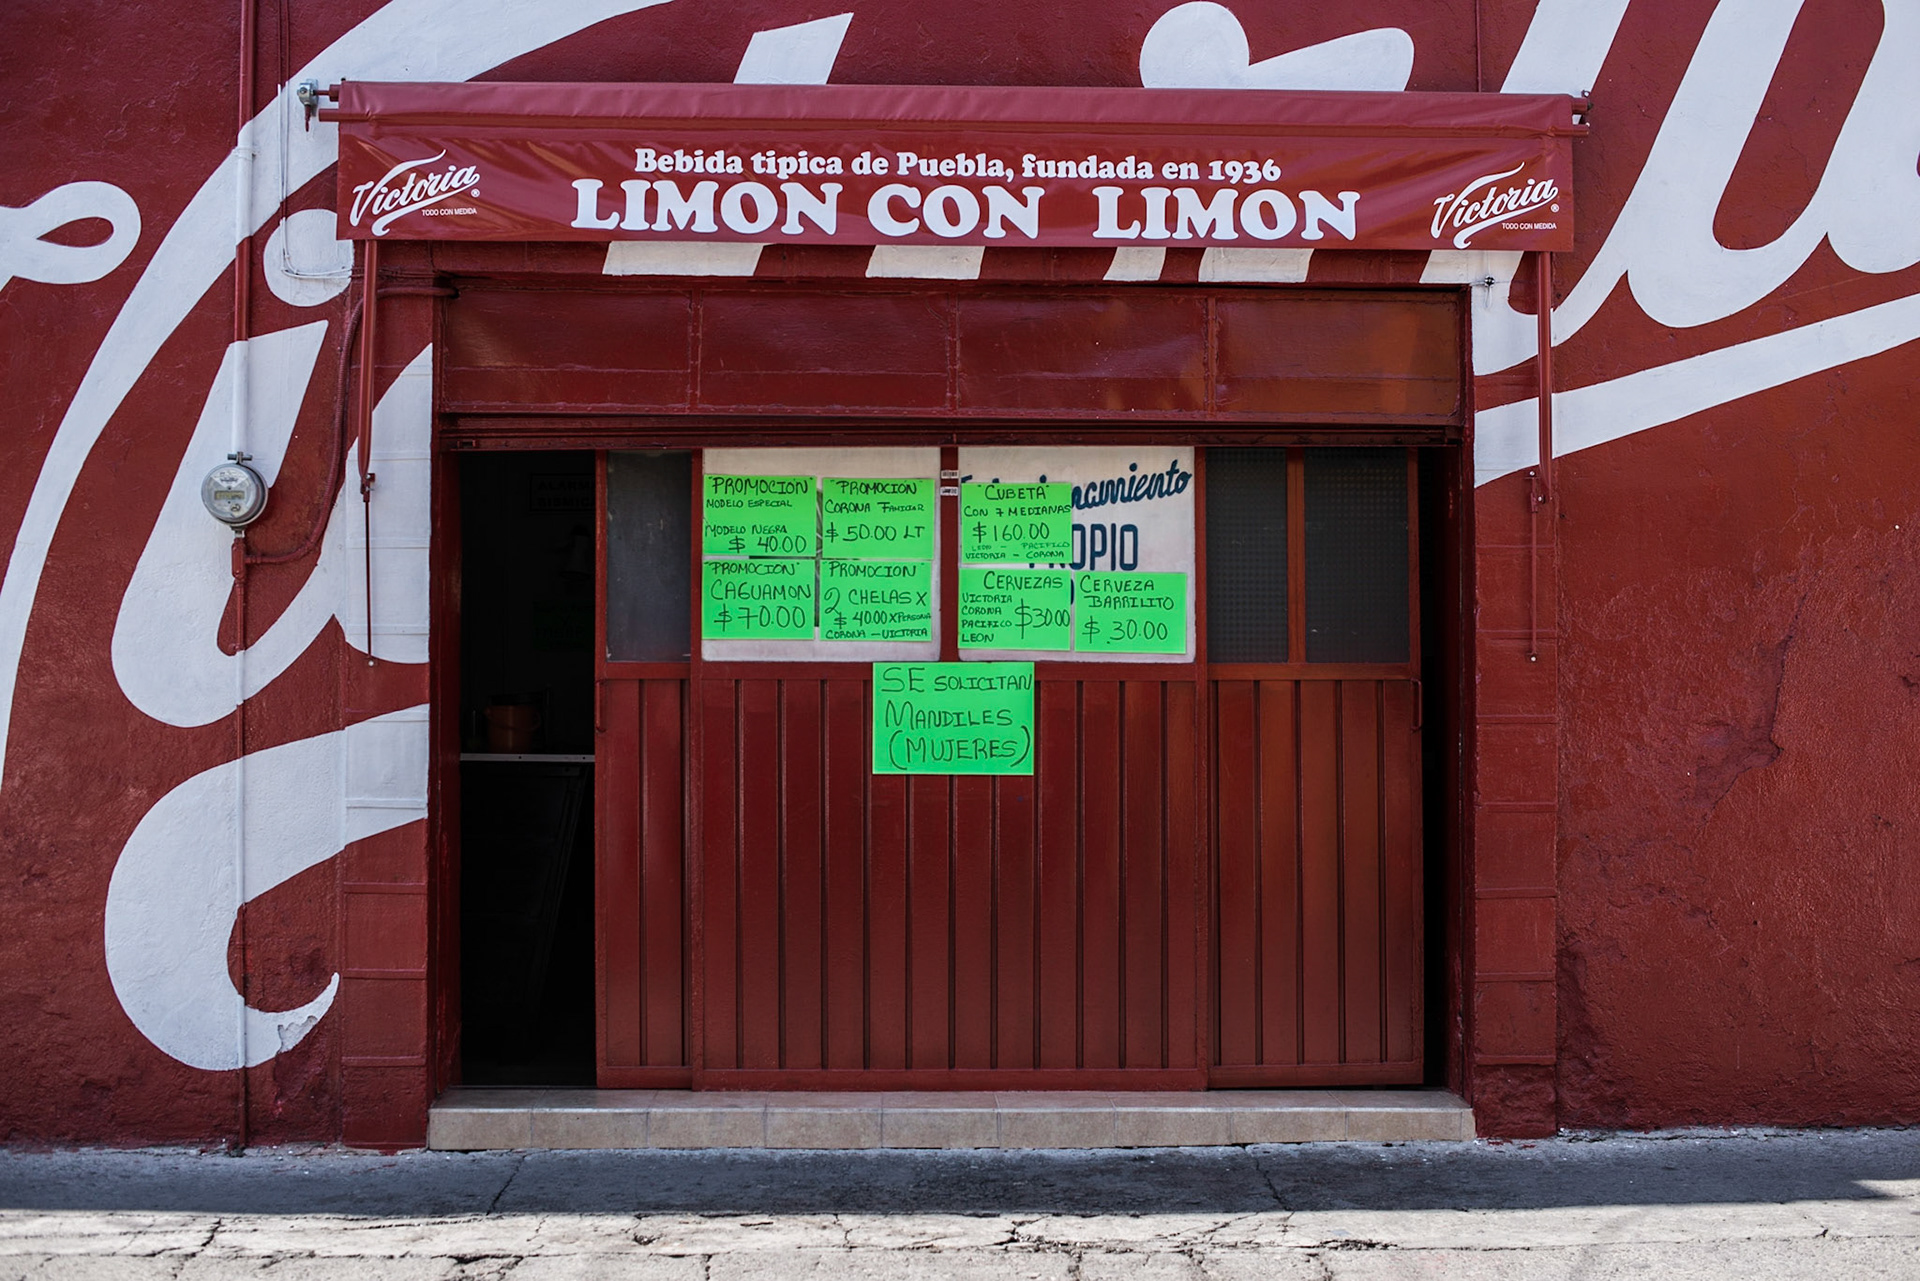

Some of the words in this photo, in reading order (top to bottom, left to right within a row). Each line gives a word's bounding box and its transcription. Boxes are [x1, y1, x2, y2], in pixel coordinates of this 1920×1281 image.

[635, 148, 743, 174] Bebida
[751, 150, 843, 179] tipica
[852, 152, 888, 175] de
[897, 152, 1014, 182] Puebla,
[1022, 154, 1154, 180] fundada
[1161, 160, 1200, 180] en
[1208, 159, 1282, 184] 1936
[349, 149, 480, 236] Victoria
[440, 208, 453, 216] CON
[454, 208, 477, 216] MEDIDA
[570, 178, 843, 236] LIMON
[867, 183, 1045, 239] CON
[1092, 186, 1361, 241] LIMON
[1430, 161, 1558, 249] Victoria
[706, 498, 744, 508] MODELO
[748, 499, 792, 508] ESPECIAL
[825, 499, 870, 514] CORONA
[963, 505, 989, 517] CON
[996, 508, 1004, 517] 7
[1008, 504, 1072, 516] MEDIANAS
[705, 524, 746, 537] MODELO
[752, 524, 787, 535] NEGRA
[903, 525, 925, 539] LT
[965, 552, 1006, 560] VICTORIA
[1026, 551, 1064, 559] CORONA
[983, 571, 1063, 591] CERVEZAS
[1080, 574, 1154, 593] CERVEZA
[711, 579, 811, 600] CAGUAMON
[824, 587, 841, 615] 2
[848, 588, 912, 605] CHELAS
[962, 592, 1012, 603] VICTORIA
[1083, 595, 1174, 610] BARRILITO
[961, 605, 1002, 615] CORONA
[961, 619, 1012, 628] PACIFICO
[825, 629, 866, 639] CORONA
[961, 633, 994, 643] LEON
[881, 667, 925, 692] SE
[934, 674, 1033, 691] SOLICITAN
[885, 700, 1013, 730] MANDILES
